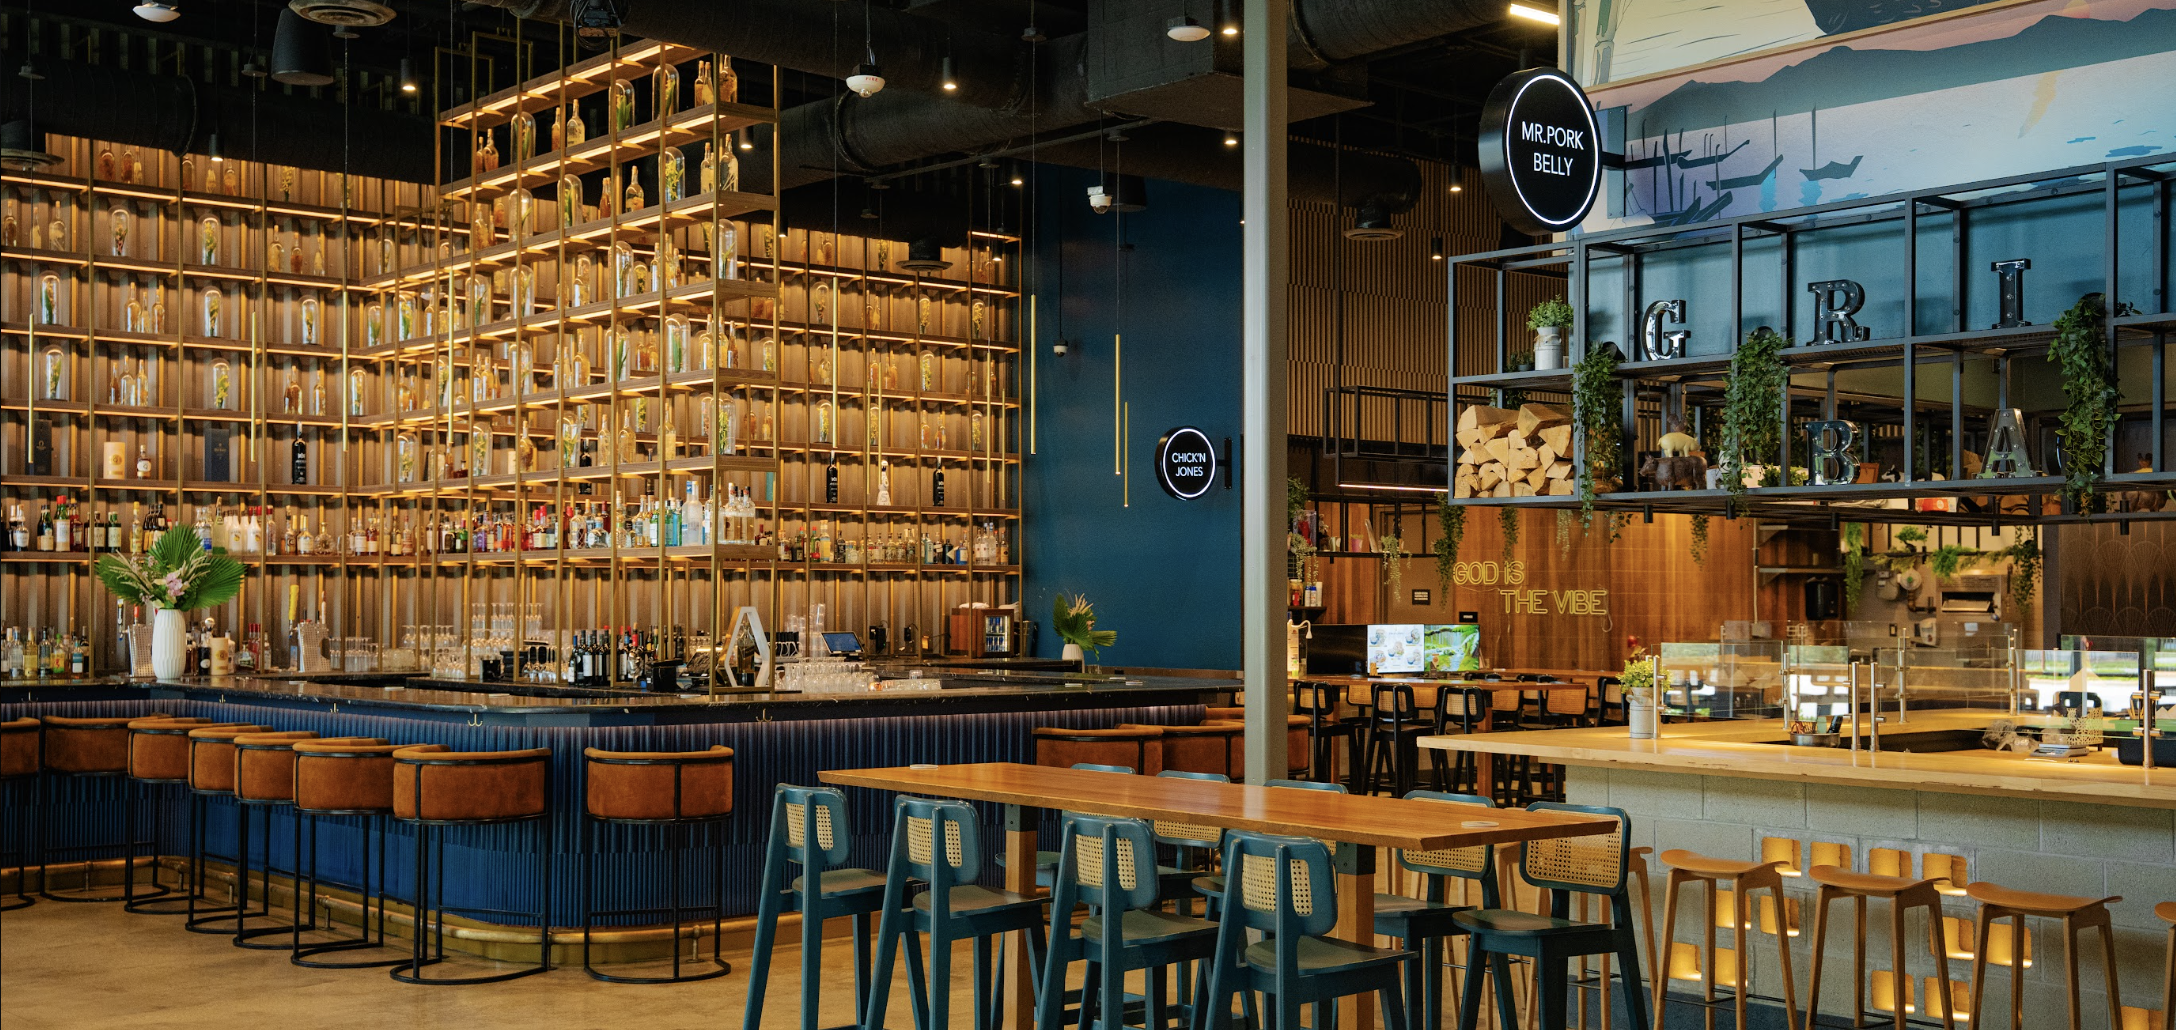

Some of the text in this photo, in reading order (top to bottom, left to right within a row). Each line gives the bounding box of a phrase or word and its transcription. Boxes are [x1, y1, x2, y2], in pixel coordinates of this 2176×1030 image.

[1533, 152, 1573, 176] BELLY
[1171, 452, 1206, 463] CHICK'N
[1175, 466, 1203, 476] JONES
[1453, 560, 1525, 585] GOD IS
[1500, 589, 1608, 615] THE VIBE
